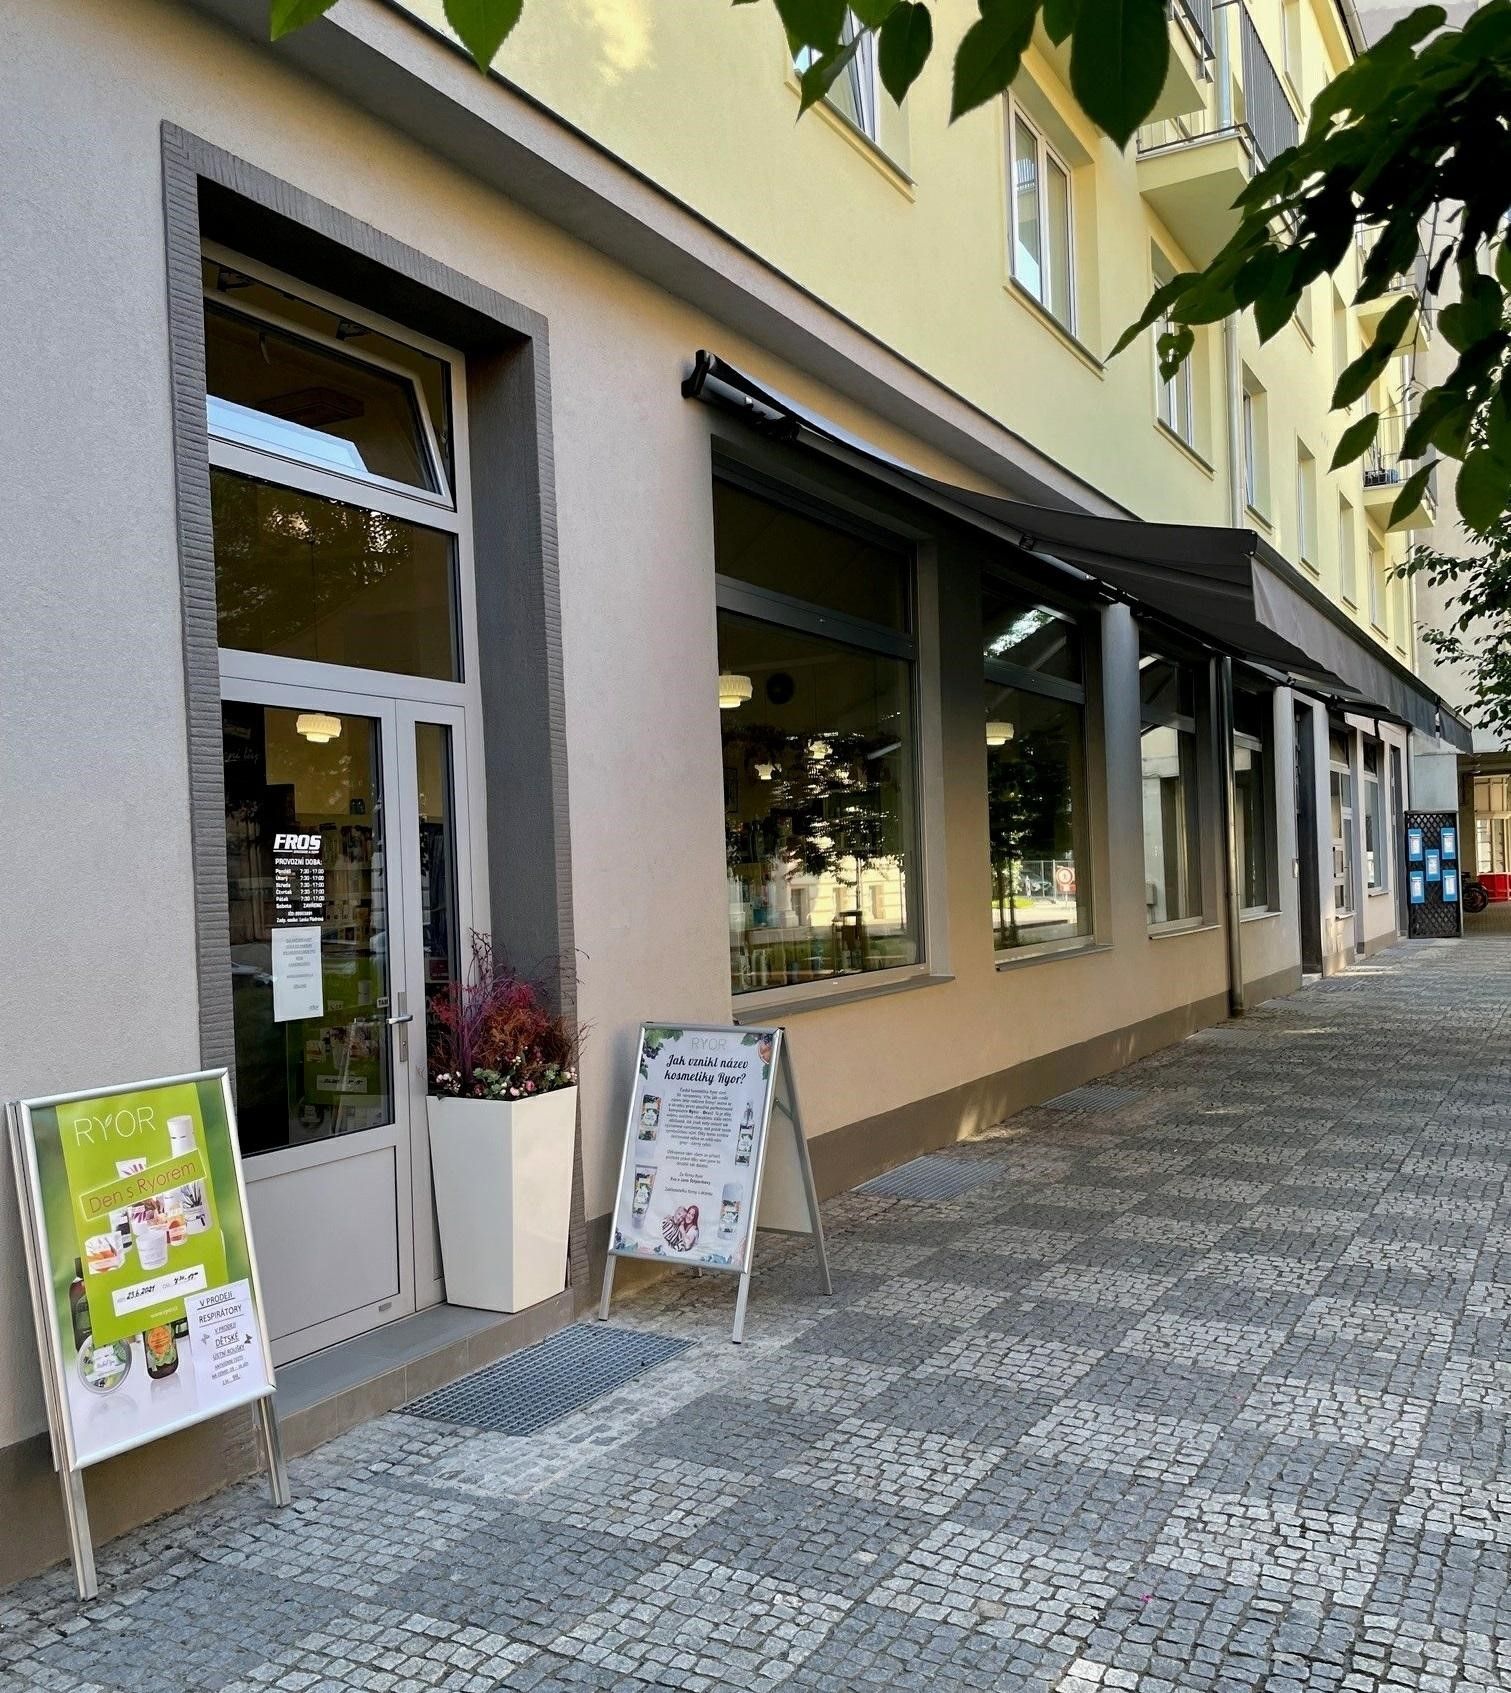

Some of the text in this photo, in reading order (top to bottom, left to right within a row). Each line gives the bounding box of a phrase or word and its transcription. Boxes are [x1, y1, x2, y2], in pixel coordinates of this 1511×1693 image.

[273, 833, 322, 850] FROS
[275, 857, 304, 865] PROVOZNÍ
[691, 1037, 727, 1051] RYOR
[666, 1054, 749, 1069] Jak vznikl název
[664, 1070, 747, 1086] kosmetiky Ryor?
[73, 1106, 156, 1146] RYOR
[89, 1162, 196, 1213] Den s Ryorem
[199, 1299, 205, 1307] V
[198, 1304, 242, 1324] RESPIRÁTORY
[215, 1331, 239, 1347] DĚTSKÉ
